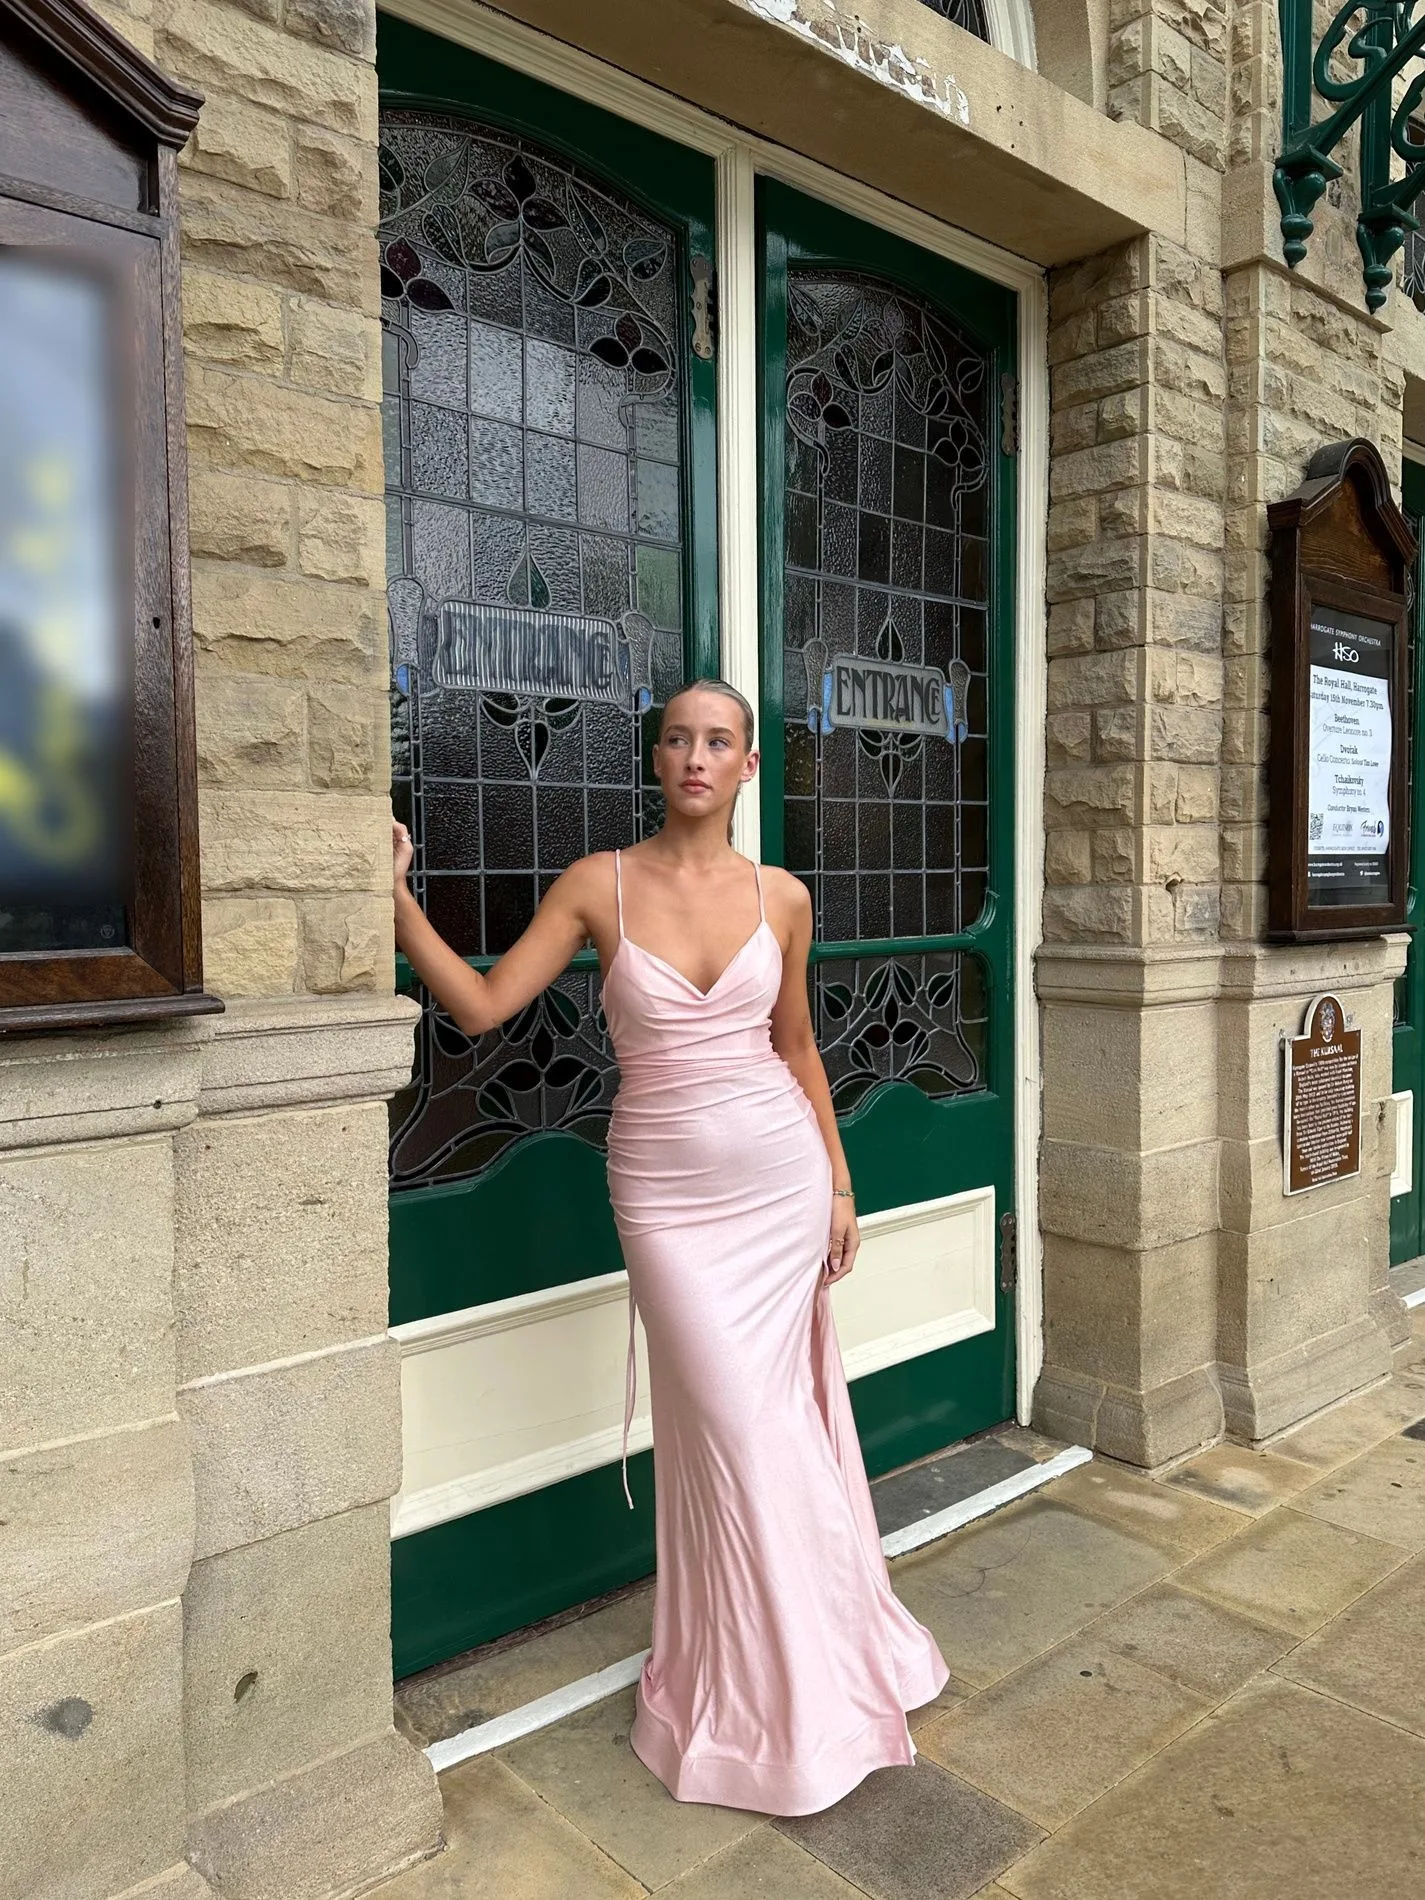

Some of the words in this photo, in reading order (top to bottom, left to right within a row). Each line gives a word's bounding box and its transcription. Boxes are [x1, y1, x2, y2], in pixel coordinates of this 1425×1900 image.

[1335, 629, 1358, 640] SYMPHONY
[1358, 635, 1381, 646] ORCHESTRA
[1332, 641, 1359, 663] HSO
[1313, 674, 1323, 685] The
[1324, 676, 1339, 689] Royal
[1340, 679, 1352, 691] Hall,
[1353, 682, 1377, 696] Harrogate
[836, 666, 942, 725] ENTRANCE
[1311, 691, 1329, 703] aturday
[1330, 694, 1340, 703] 15th
[1341, 695, 1365, 707] November
[1334, 713, 1360, 725] Beethoven
[1323, 723, 1342, 734] Overture
[1317, 753, 1328, 762] Cello
[1334, 774, 1364, 786] Tchaikovsky
[1332, 786, 1356, 797] Symphony
